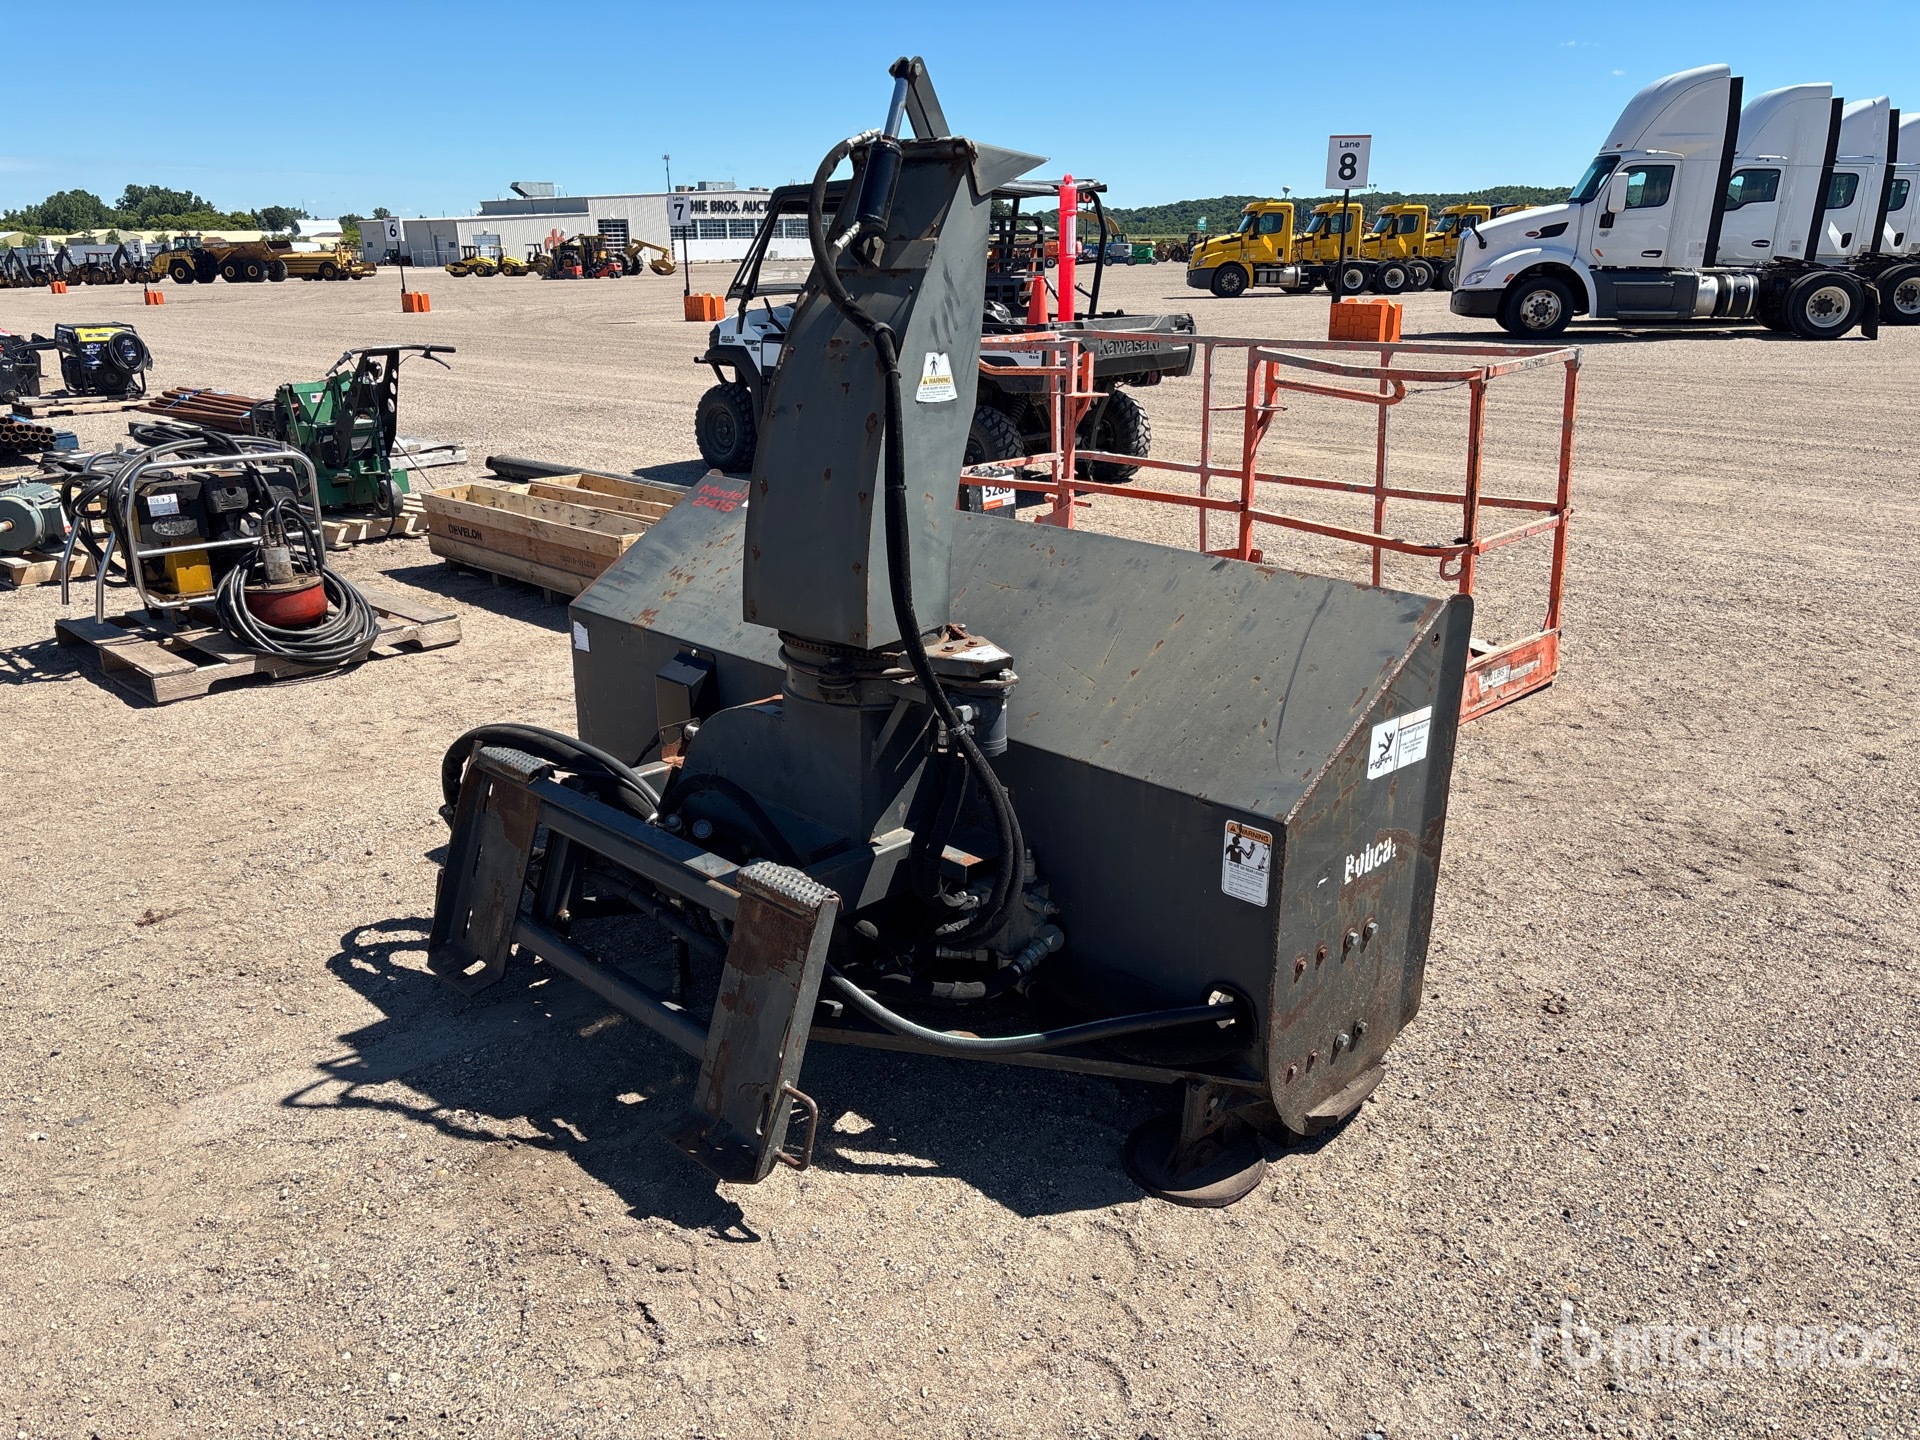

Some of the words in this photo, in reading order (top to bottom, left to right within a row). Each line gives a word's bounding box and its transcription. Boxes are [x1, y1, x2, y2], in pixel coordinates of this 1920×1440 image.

[1339, 140, 1360, 148] Lane
[1338, 152, 1357, 181] 8
[673, 203, 684, 220] 7
[710, 200, 740, 212] BROS.
[742, 200, 769, 212] AUCT
[389, 224, 397, 237] 6
[41, 242, 46, 250] 4
[133, 244, 140, 254] 5
[929, 376, 951, 384] WARNING
[698, 484, 749, 501] Model
